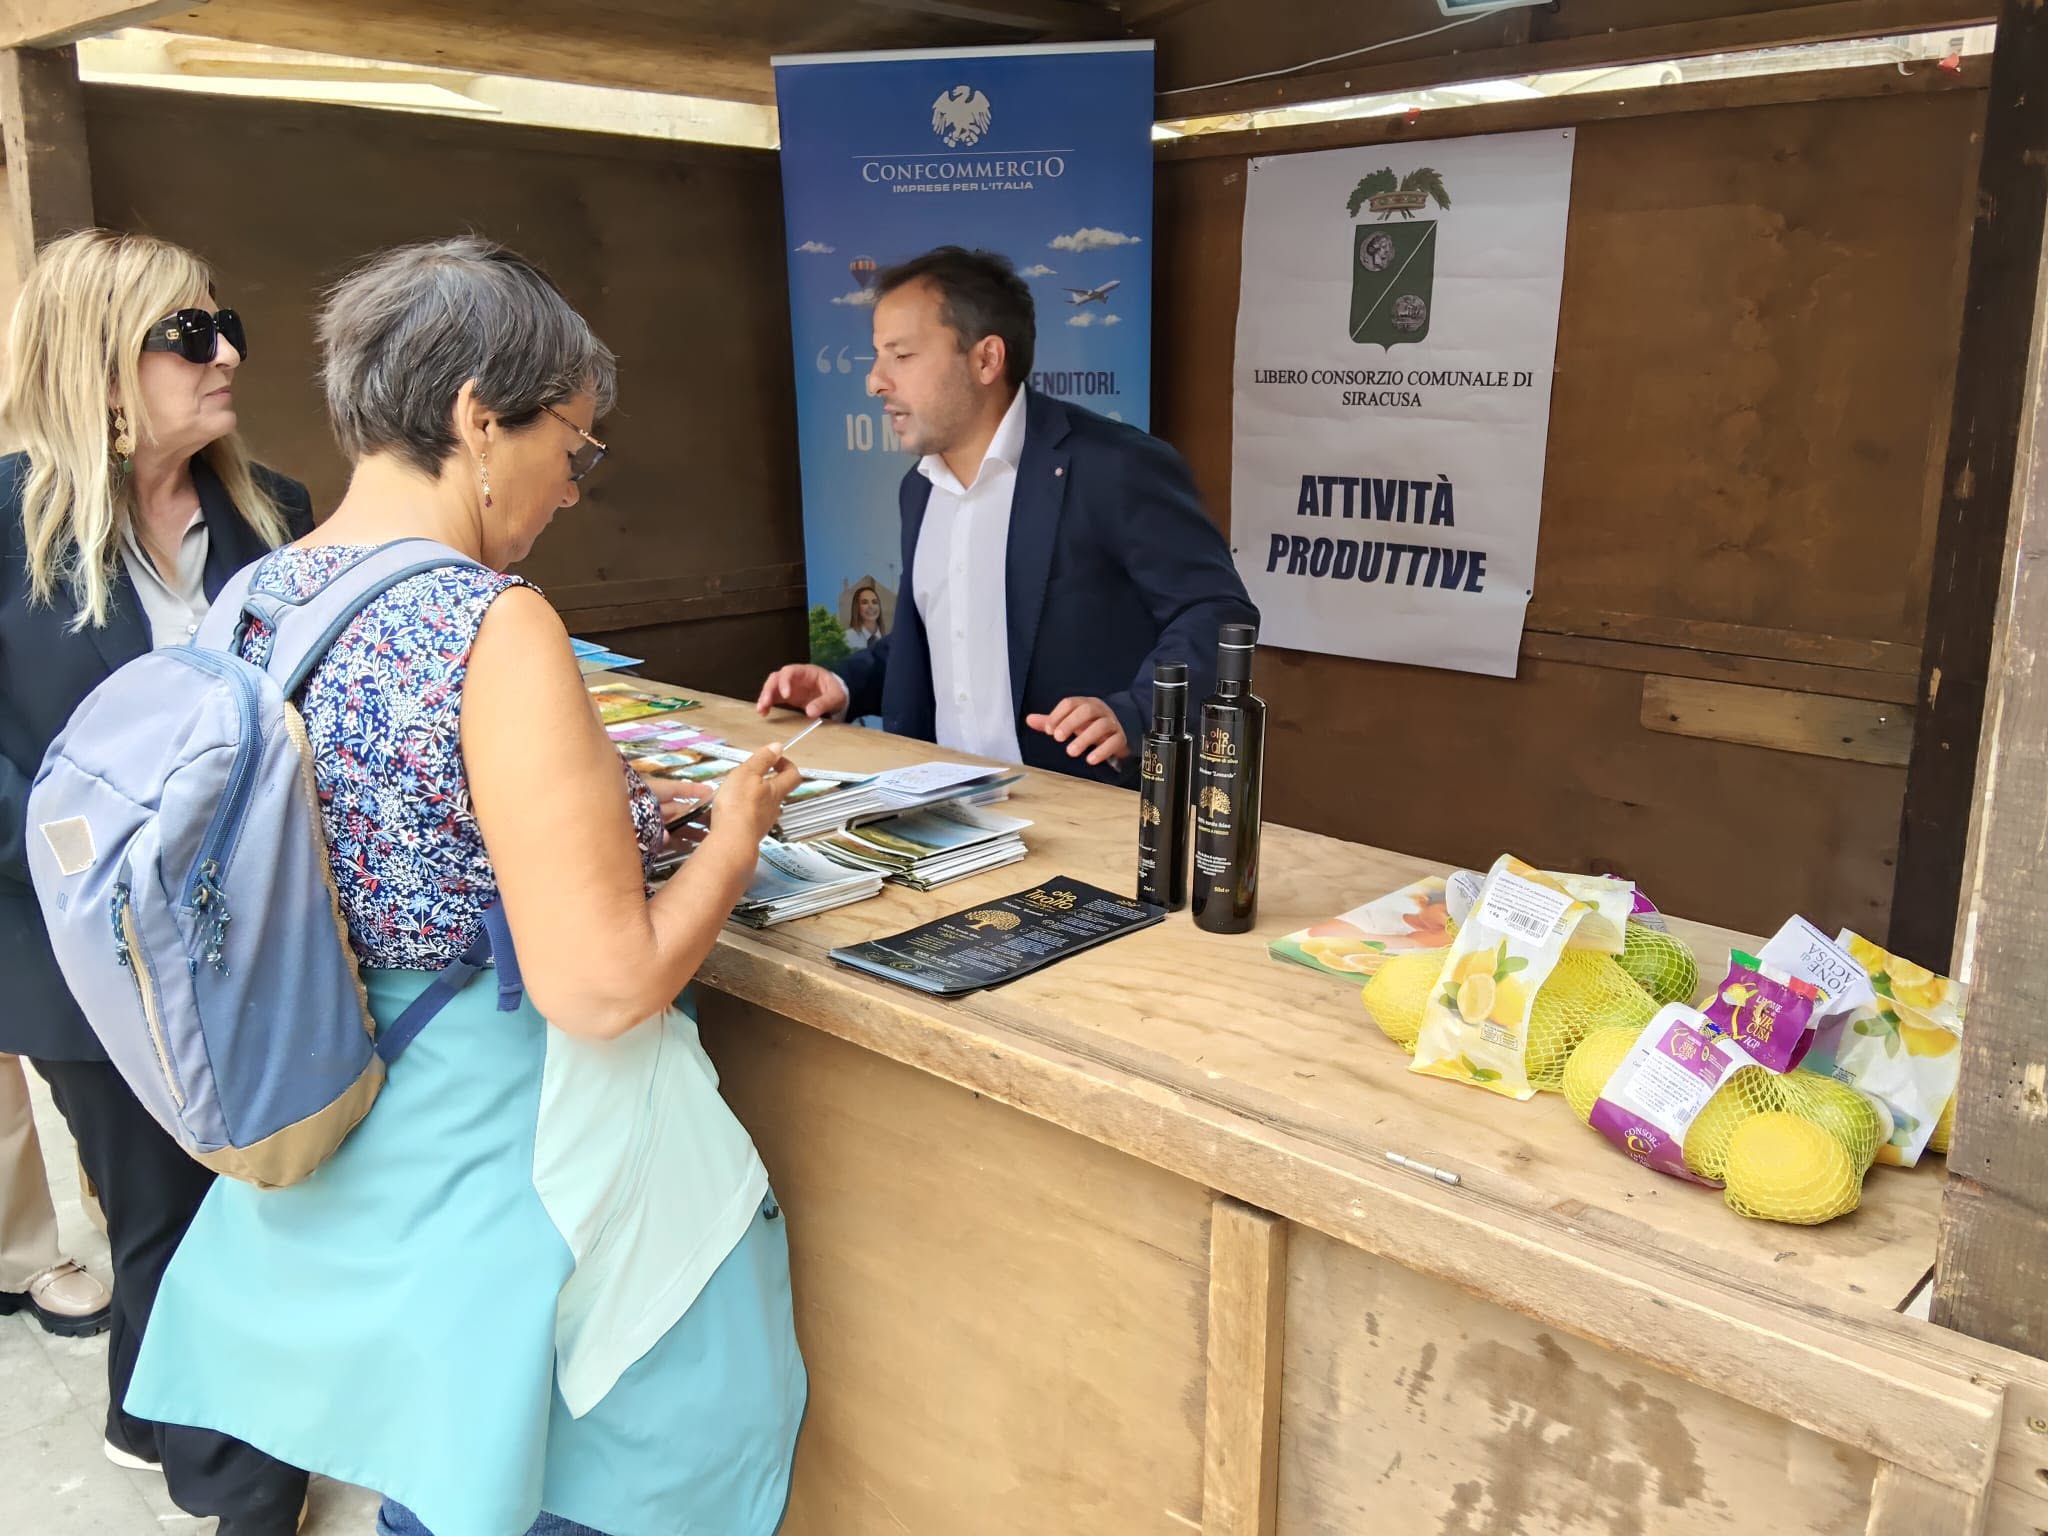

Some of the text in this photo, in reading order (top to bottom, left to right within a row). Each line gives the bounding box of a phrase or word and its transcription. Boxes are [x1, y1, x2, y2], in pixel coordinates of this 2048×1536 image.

[862, 156, 1065, 183] CONFCOMMERCIO
[893, 181, 1034, 193] IMPRESE PER L'ITALIA
[1032, 371, 1120, 395] ENDITORI.
[1254, 369, 1533, 387] LIBERO CONSORZIO COMUNALE DI
[1342, 391, 1422, 407] SIRACUSA
[1297, 473, 1455, 527] ATTIVITÀ
[1266, 533, 1487, 593] PRODUTTIVE
[1808, 942, 1858, 983] ACUSA
[1746, 1022, 1771, 1044] CUSA
